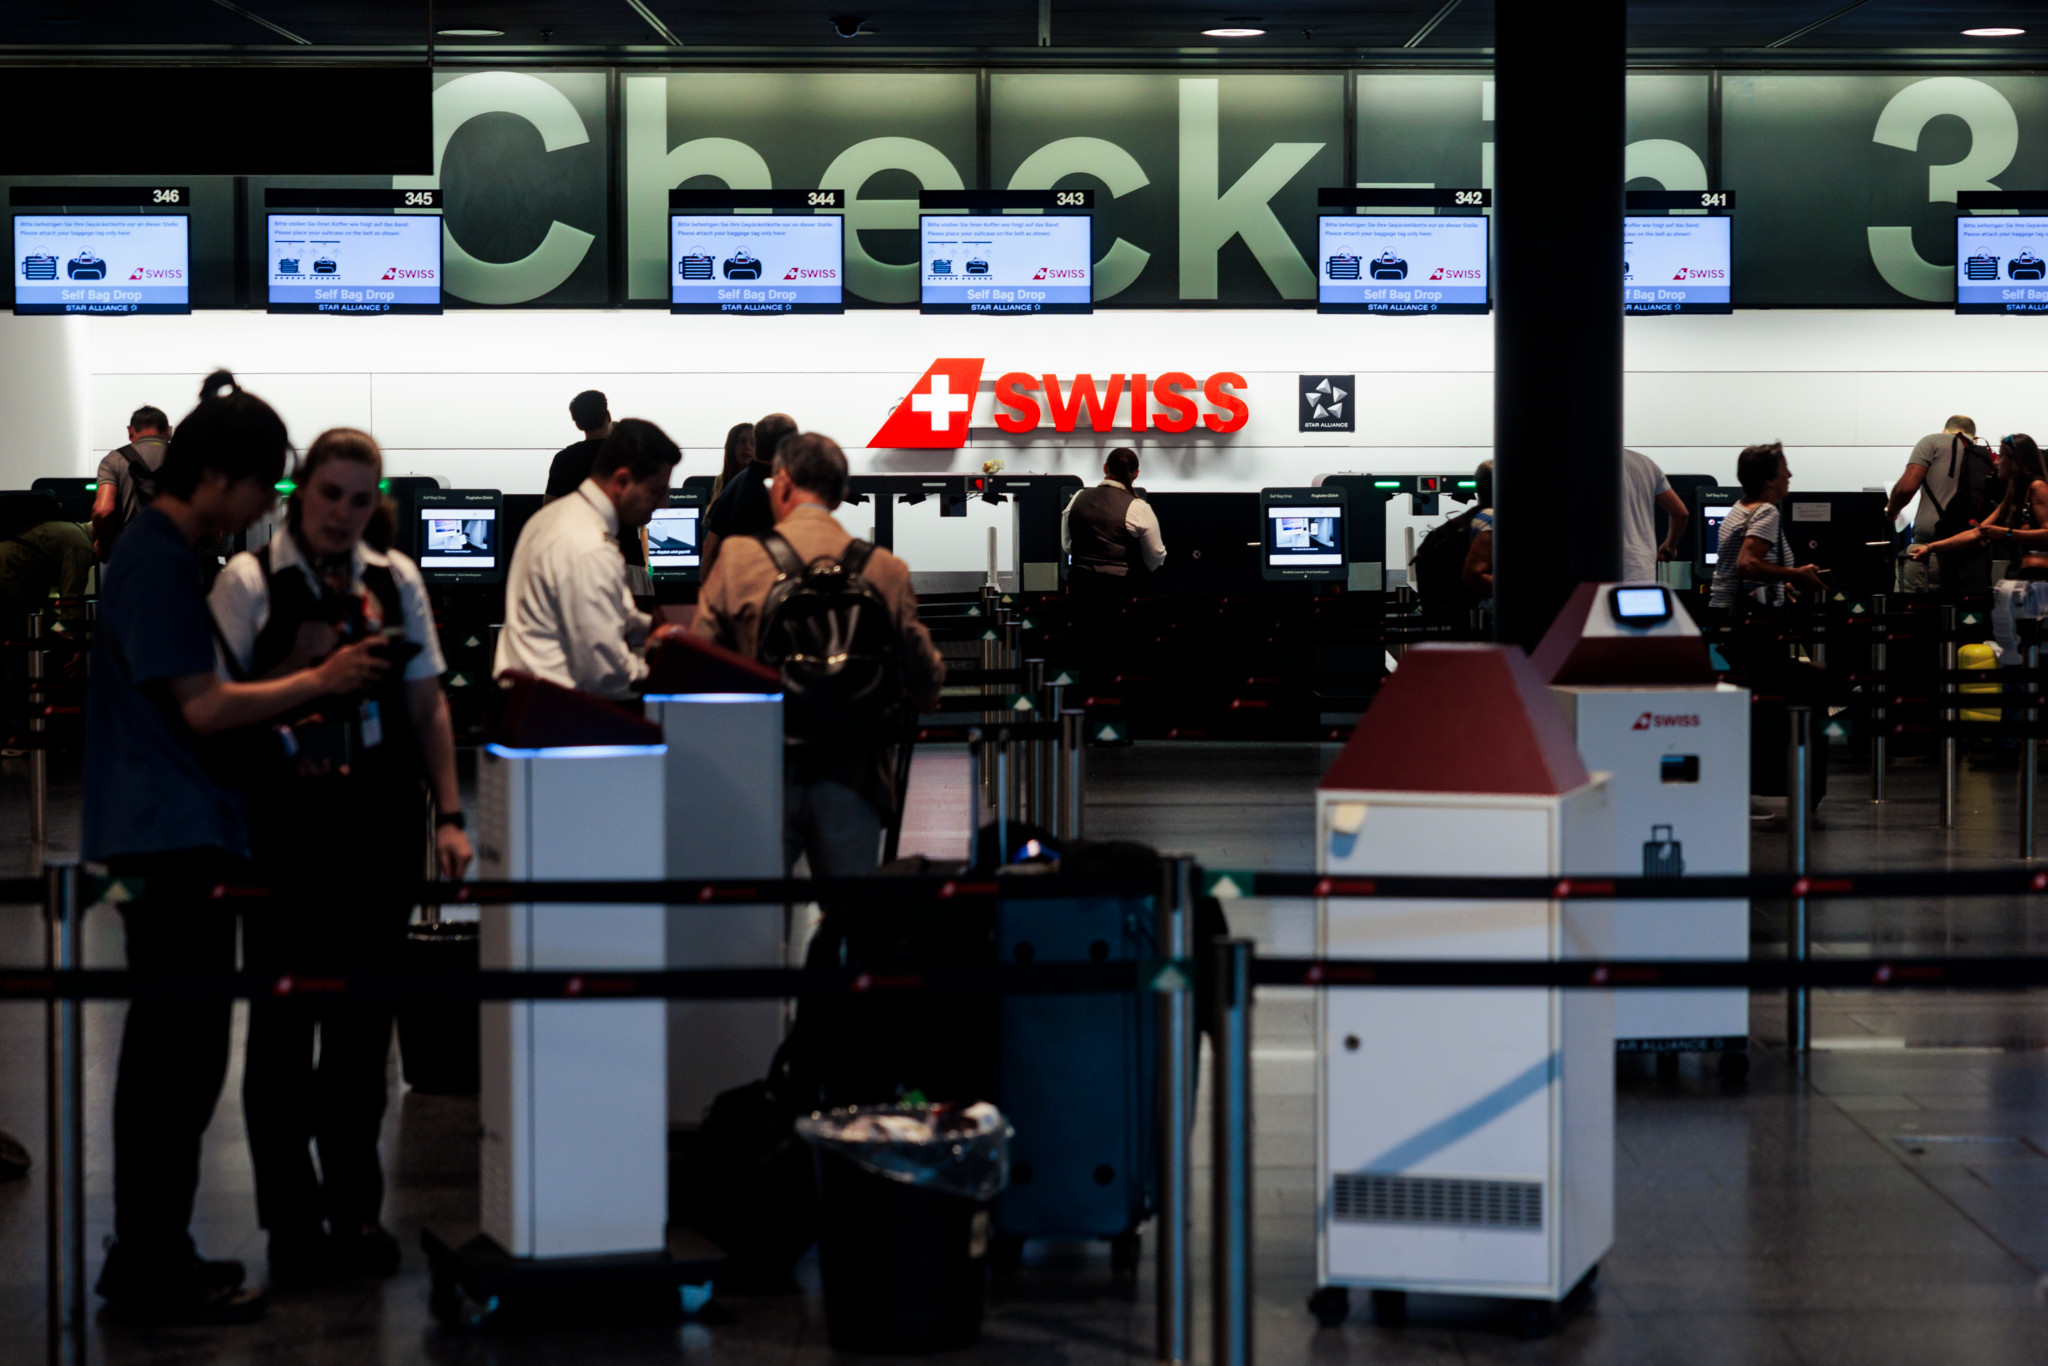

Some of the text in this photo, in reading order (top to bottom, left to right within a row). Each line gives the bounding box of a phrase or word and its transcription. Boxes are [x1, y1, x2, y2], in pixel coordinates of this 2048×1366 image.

[392, 71, 2020, 305] Check 3
[153, 189, 179, 203] 346
[405, 192, 433, 205] 345
[808, 192, 835, 205] 344
[1057, 192, 1084, 205] 343
[1455, 191, 1482, 204] 342
[1701, 193, 1726, 206] 341
[146, 269, 182, 279] SWISS
[398, 270, 434, 278] SWISS
[801, 269, 836, 278] SWISS
[1049, 270, 1085, 278] SWISS
[1446, 270, 1481, 279] SWISS
[1689, 270, 1724, 278] SWISS
[62, 289, 142, 301] Self Bag Drop
[315, 289, 394, 301] Self Bag Drop
[718, 289, 796, 301] Self Bag Drop
[967, 289, 1045, 301] Self Bag Drop
[1364, 289, 1442, 301] Self Bag Drop
[1634, 289, 1655, 301] Bag
[1658, 289, 1686, 301] Drop
[2002, 289, 2048, 301] Self Bag
[994, 371, 1248, 434] SWISS
[1653, 714, 1700, 728] SWISS
